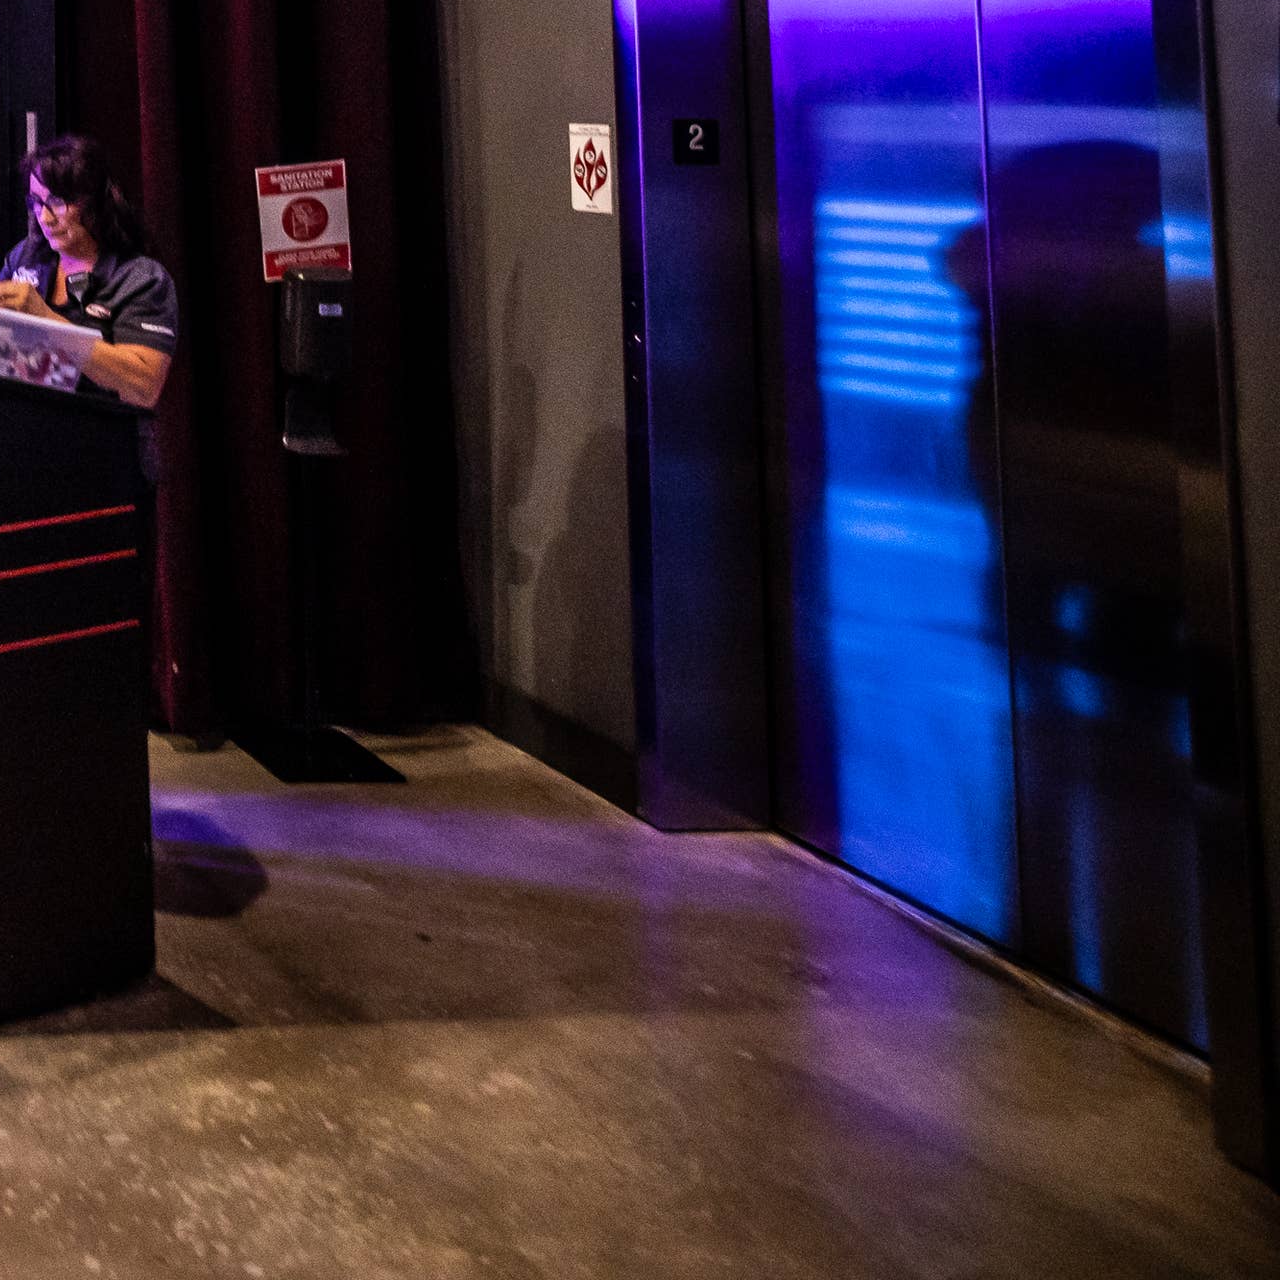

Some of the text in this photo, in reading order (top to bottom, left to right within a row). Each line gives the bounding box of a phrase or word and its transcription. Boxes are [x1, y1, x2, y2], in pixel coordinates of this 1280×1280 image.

[689, 123, 704, 150] 2
[270, 168, 333, 185] SANITATION
[280, 177, 325, 192] STATION
